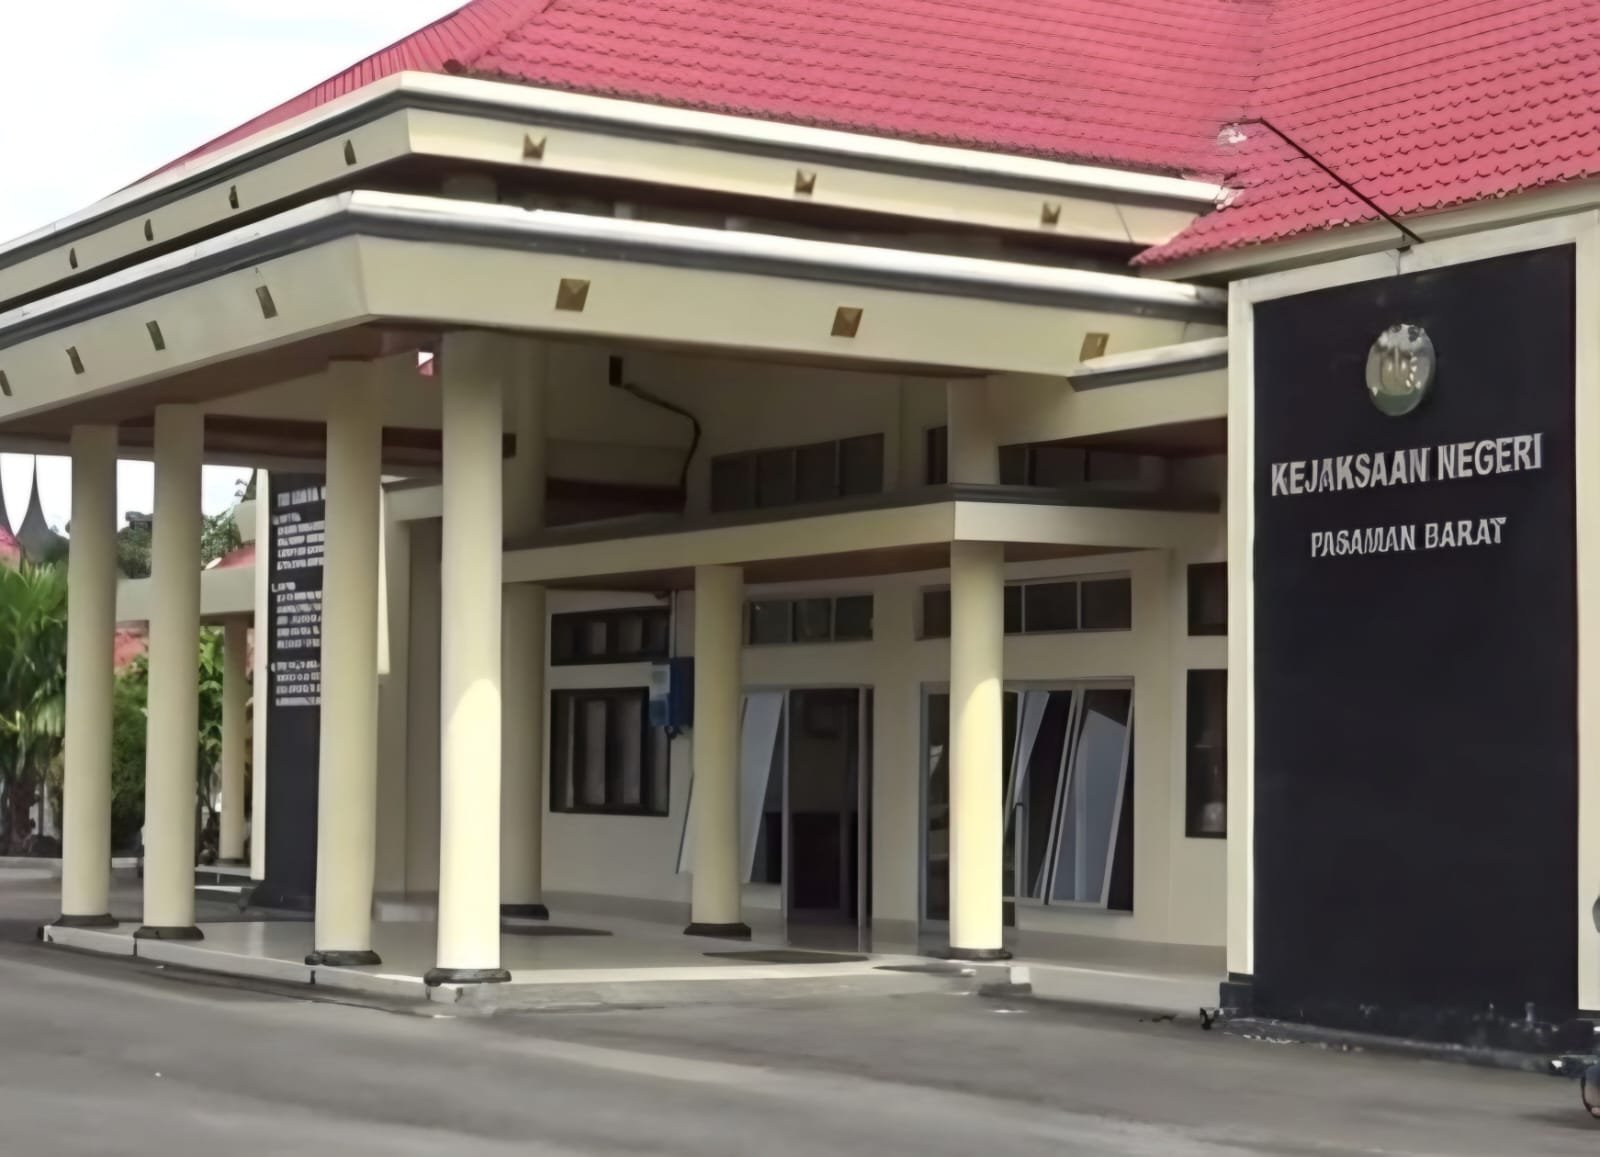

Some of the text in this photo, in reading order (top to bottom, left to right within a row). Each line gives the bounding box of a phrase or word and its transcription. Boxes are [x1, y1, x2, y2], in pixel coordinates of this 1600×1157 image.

[1271, 433, 1543, 496] KEJAKSAAN NEGERI
[1311, 516, 1507, 557] PASAMAN BARAT
